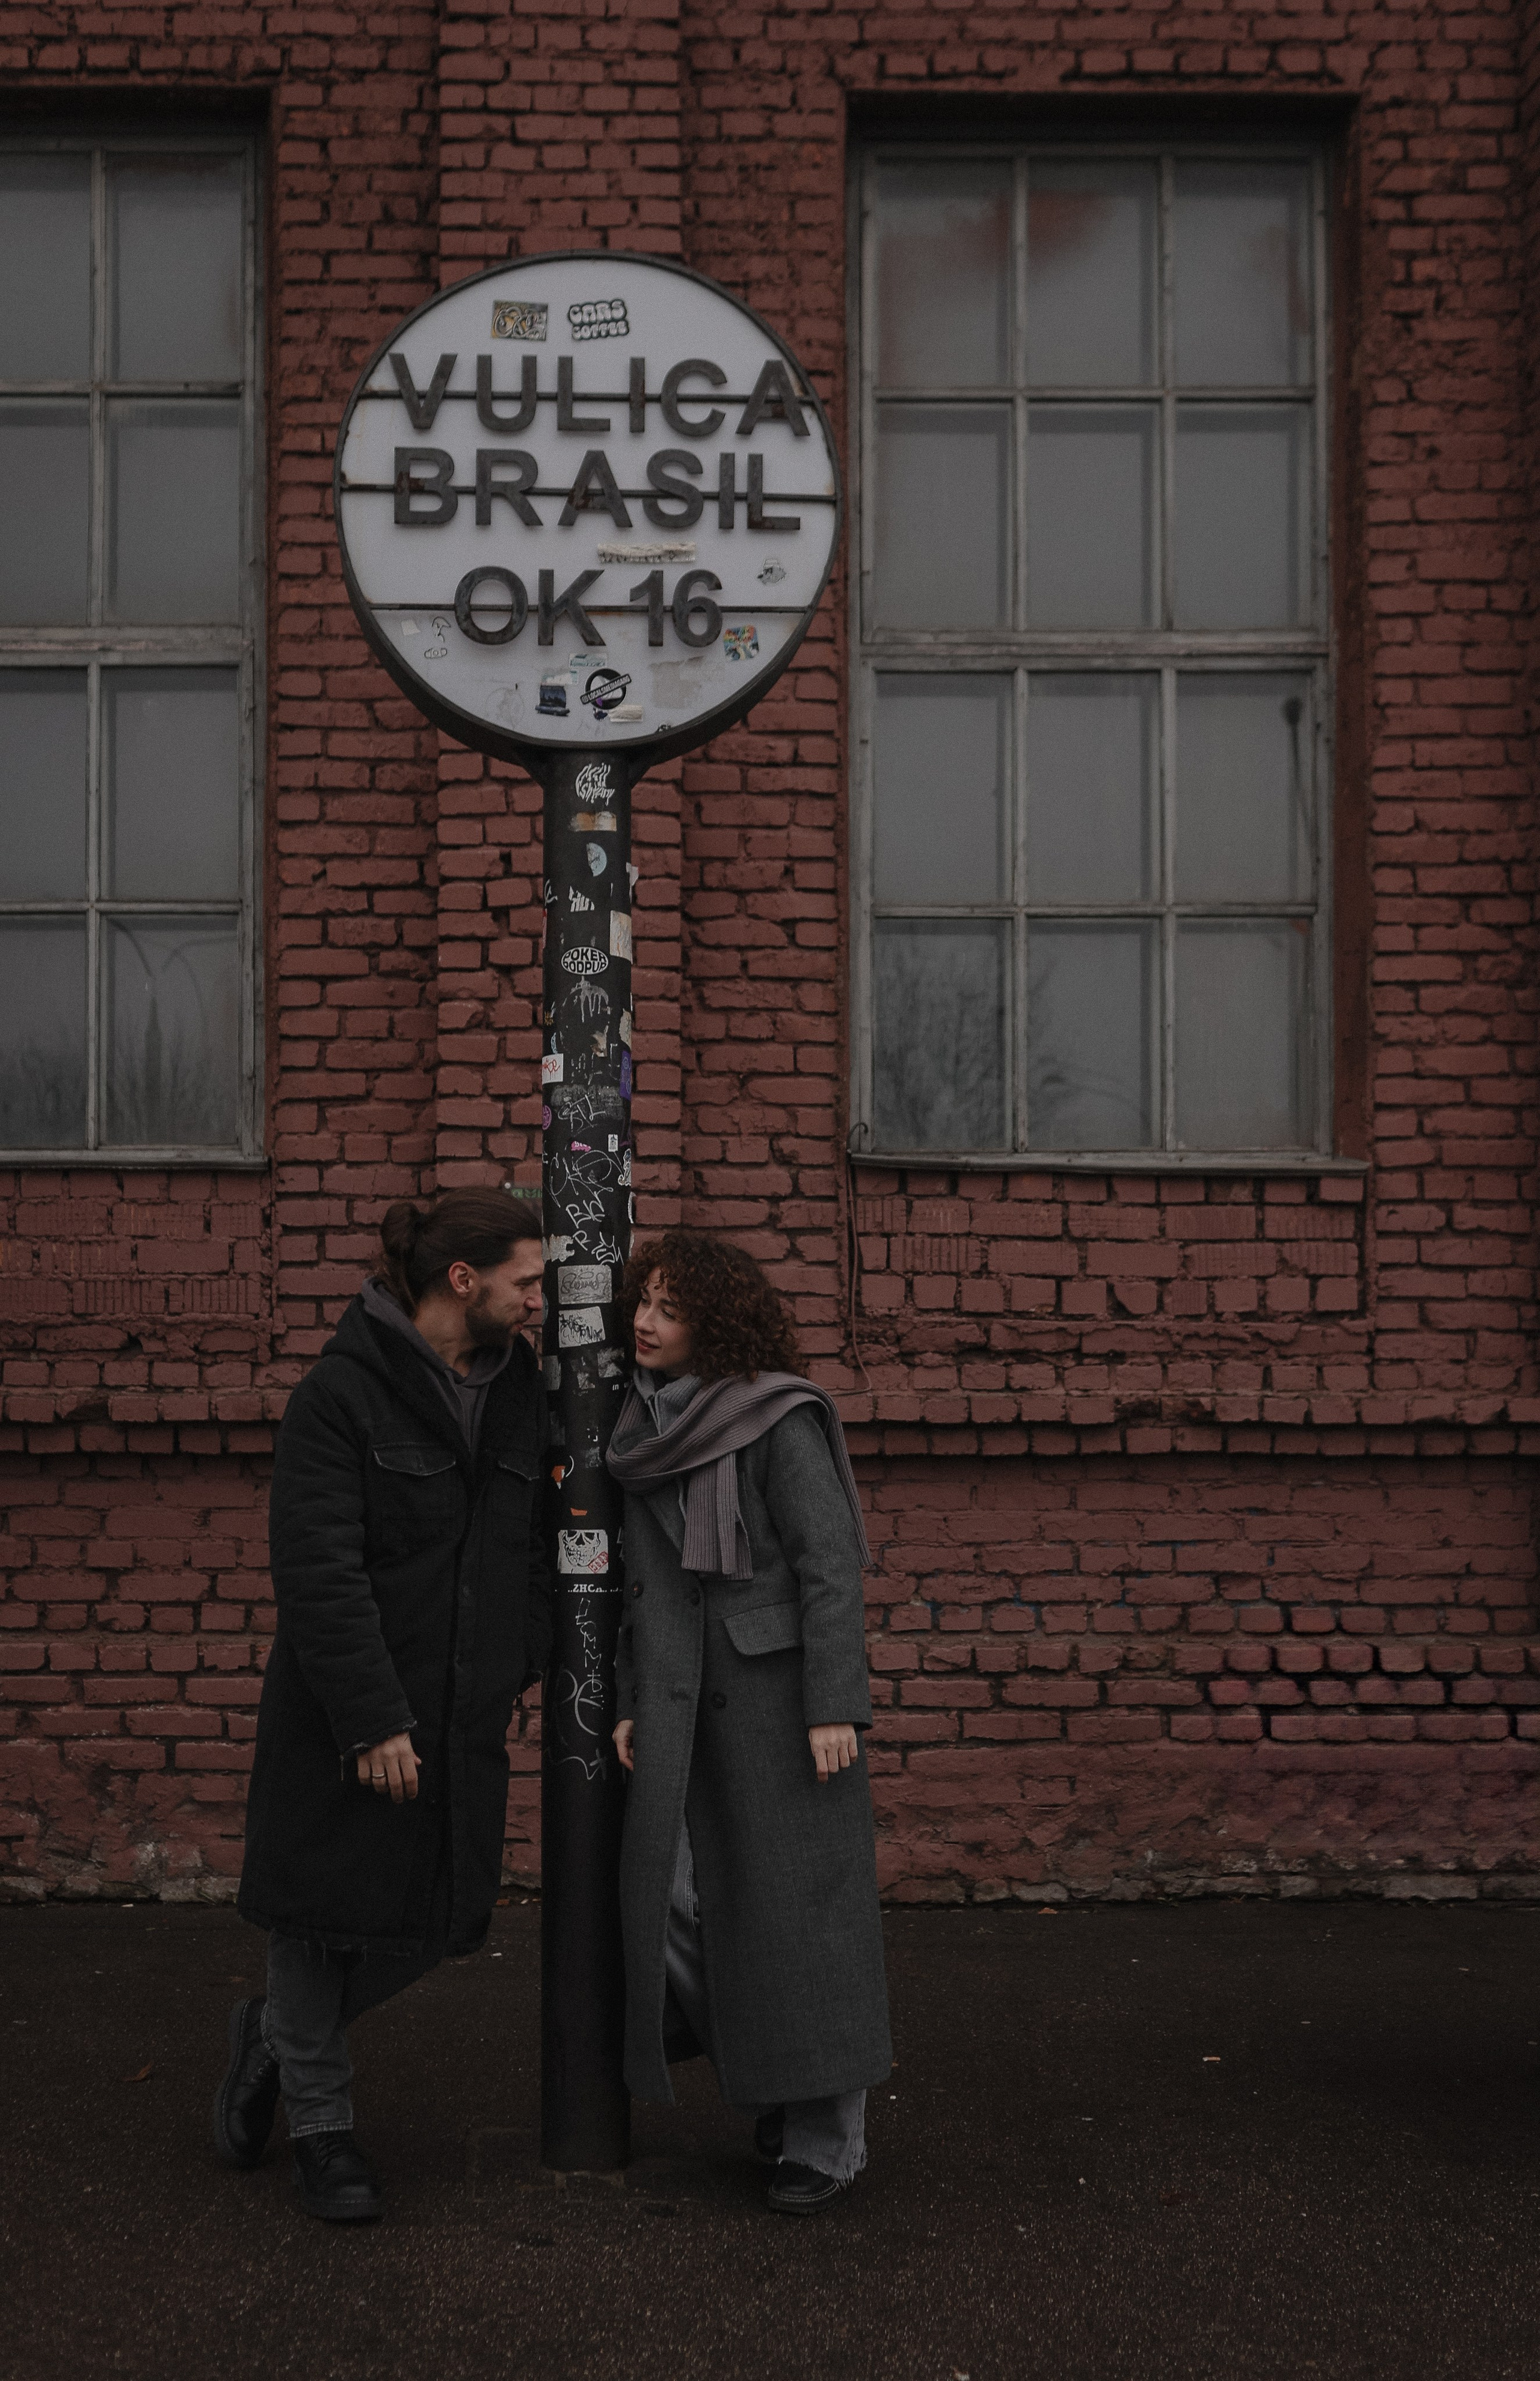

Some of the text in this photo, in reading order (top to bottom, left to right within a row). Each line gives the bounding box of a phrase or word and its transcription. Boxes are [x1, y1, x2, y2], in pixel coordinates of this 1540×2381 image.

[387, 352, 810, 437] VULICA
[393, 447, 800, 530] BRASIL
[454, 565, 722, 647] OK 16
[563, 948, 607, 962] POKER
